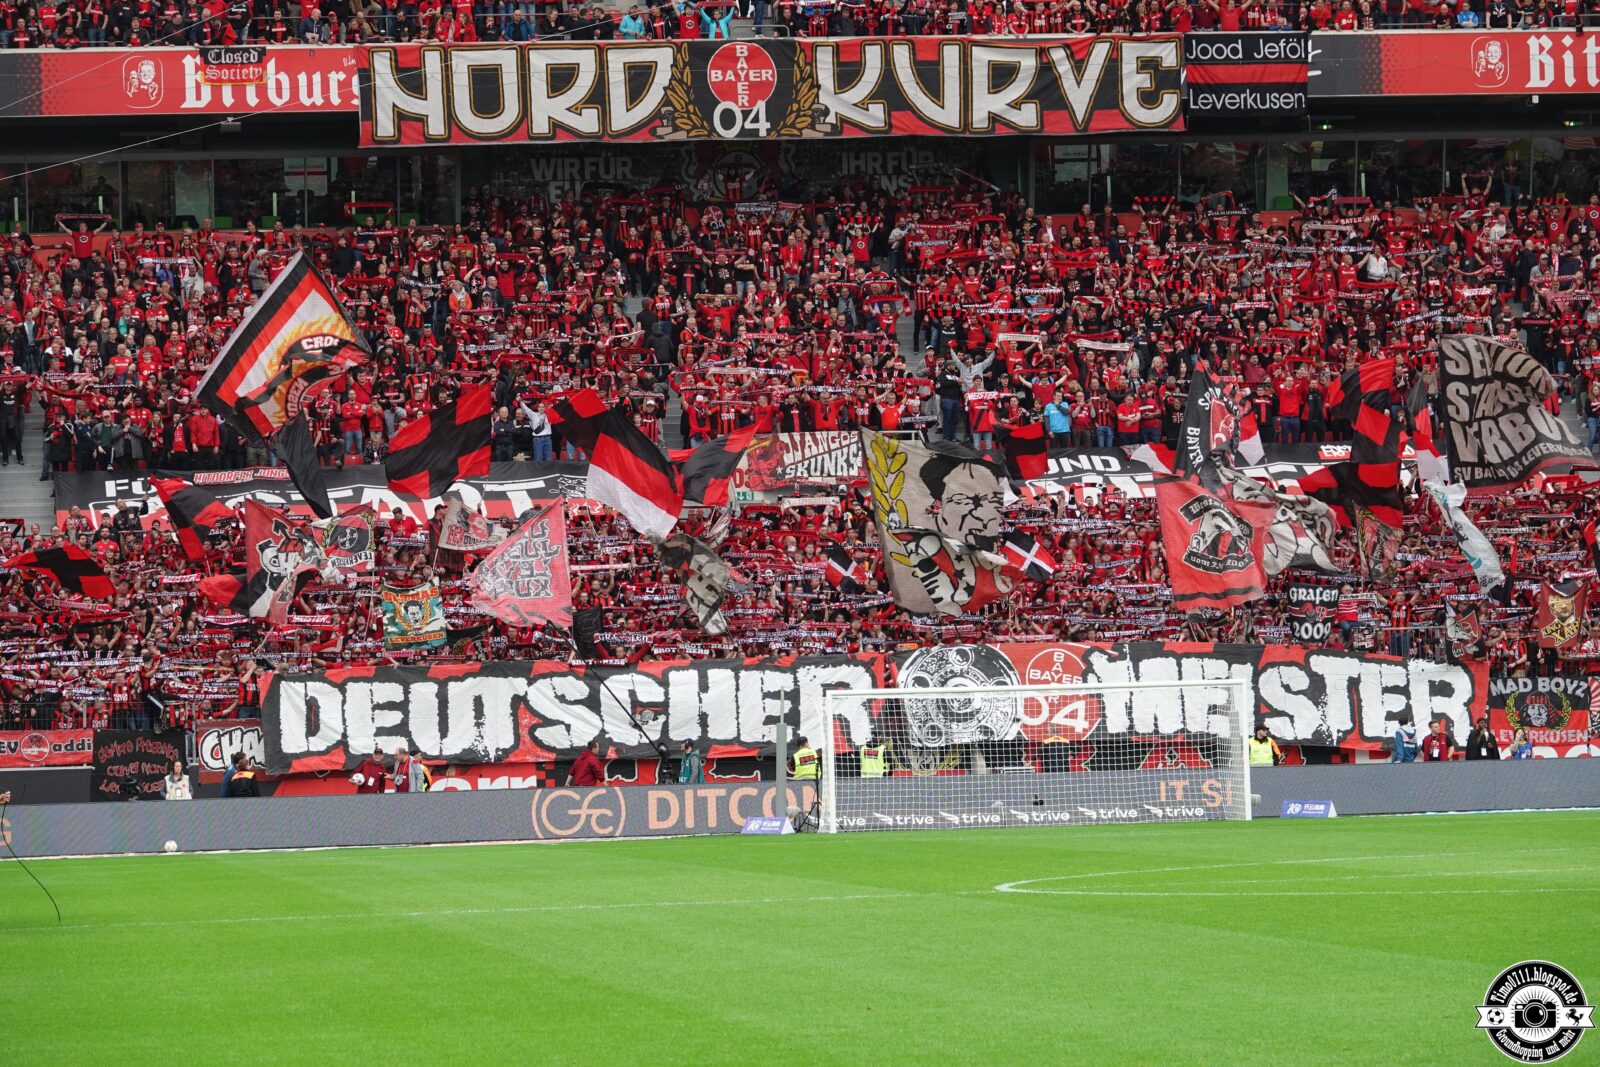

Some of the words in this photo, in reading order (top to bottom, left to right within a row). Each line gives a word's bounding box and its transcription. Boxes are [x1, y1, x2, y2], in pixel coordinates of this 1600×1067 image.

[207, 47, 259, 64] Closed
[1186, 39, 1243, 60] Jood
[1253, 38, 1305, 59] Jeföl
[205, 65, 263, 82] Society
[710, 69, 774, 82] BAYER
[812, 38, 1183, 132] KURVE
[1189, 88, 1306, 110] Leverkusen
[713, 100, 771, 138] 04
[784, 444, 860, 479] SKUNKS
[1292, 621, 1332, 640] 2009
[1489, 677, 1533, 697] MAD
[1537, 677, 1588, 699] BOYZ
[279, 662, 875, 762] DEUTSCHER
[52, 737, 92, 752] addi
[961, 812, 1001, 824] trive
[1030, 810, 1071, 822] trive
[1099, 807, 1138, 819] trive
[1164, 805, 1204, 817] trive
[895, 814, 935, 826] trive
